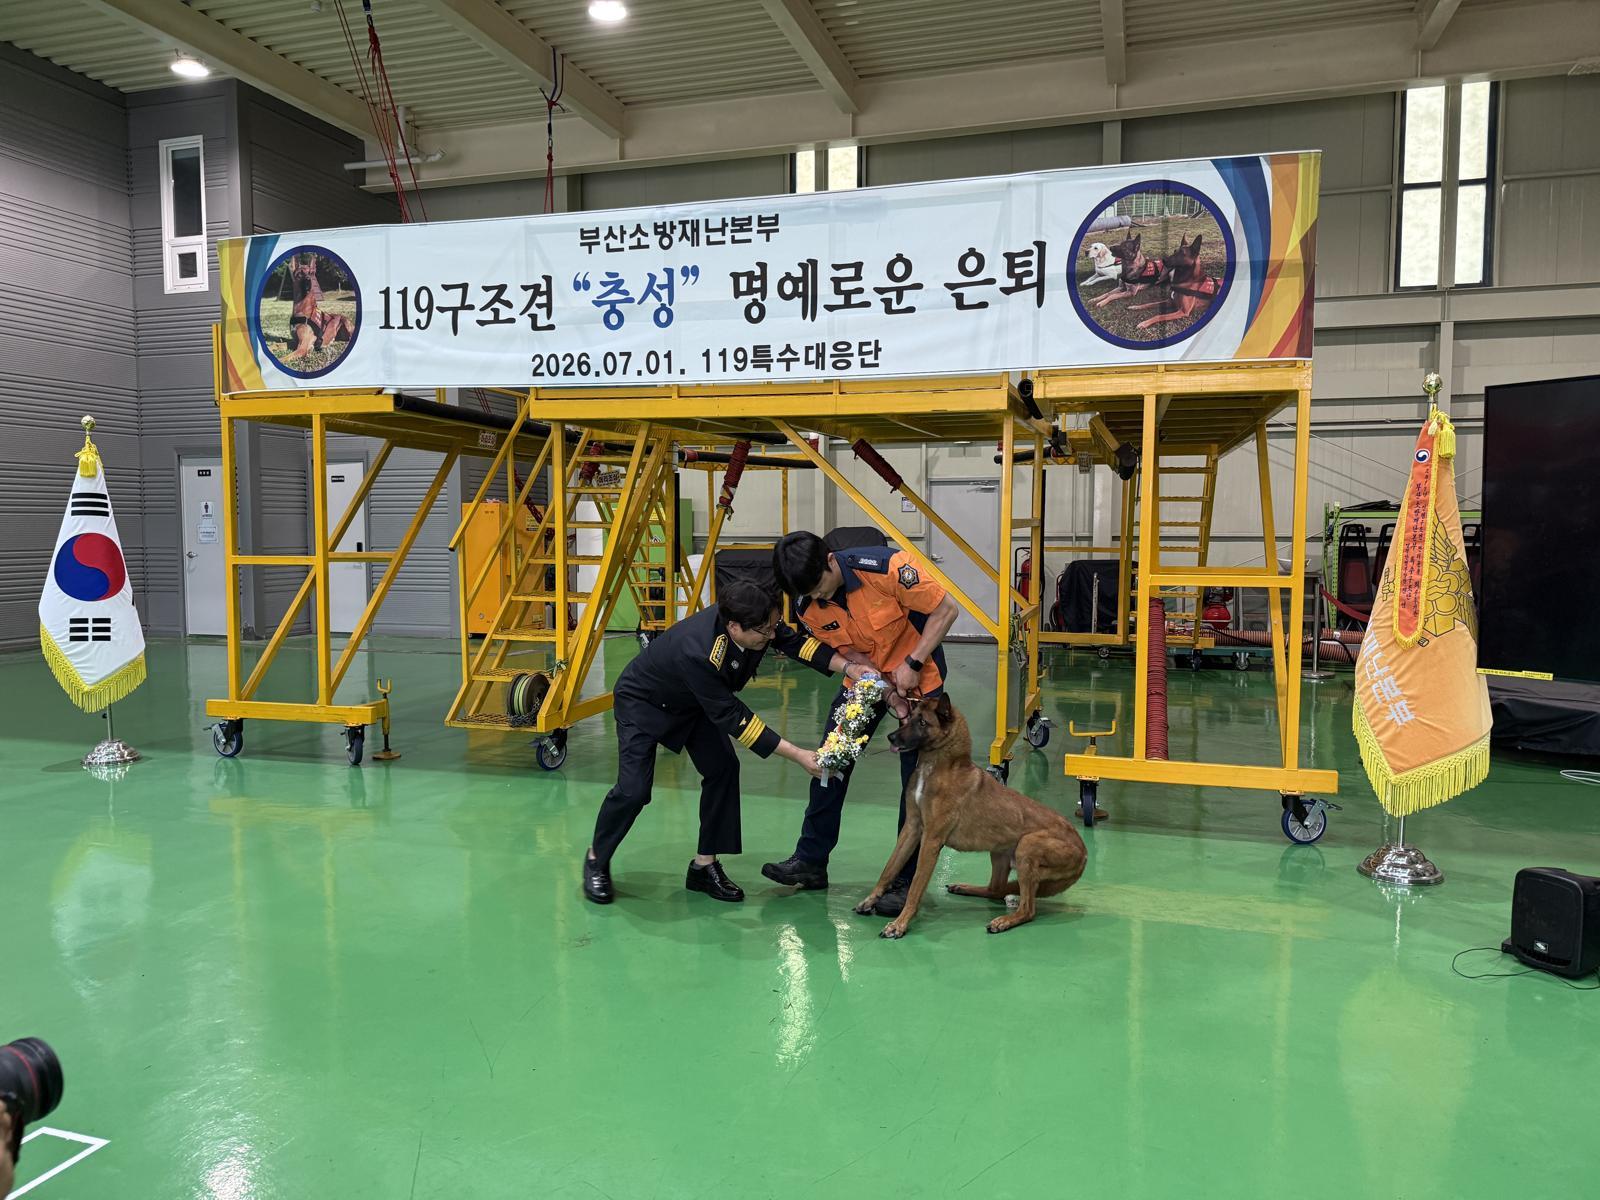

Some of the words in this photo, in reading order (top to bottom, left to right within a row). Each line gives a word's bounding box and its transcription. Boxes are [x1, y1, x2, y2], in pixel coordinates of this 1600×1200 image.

[579, 214, 780, 254] 부산소방재난본부
[379, 275, 556, 337] 119구조견
[573, 265, 700, 331] “충성”
[729, 252, 924, 325] 명예로운
[944, 240, 1048, 310] 은퇴
[532, 350, 686, 378] 2026.07.01.
[702, 339, 882, 373] 119특수대응단
